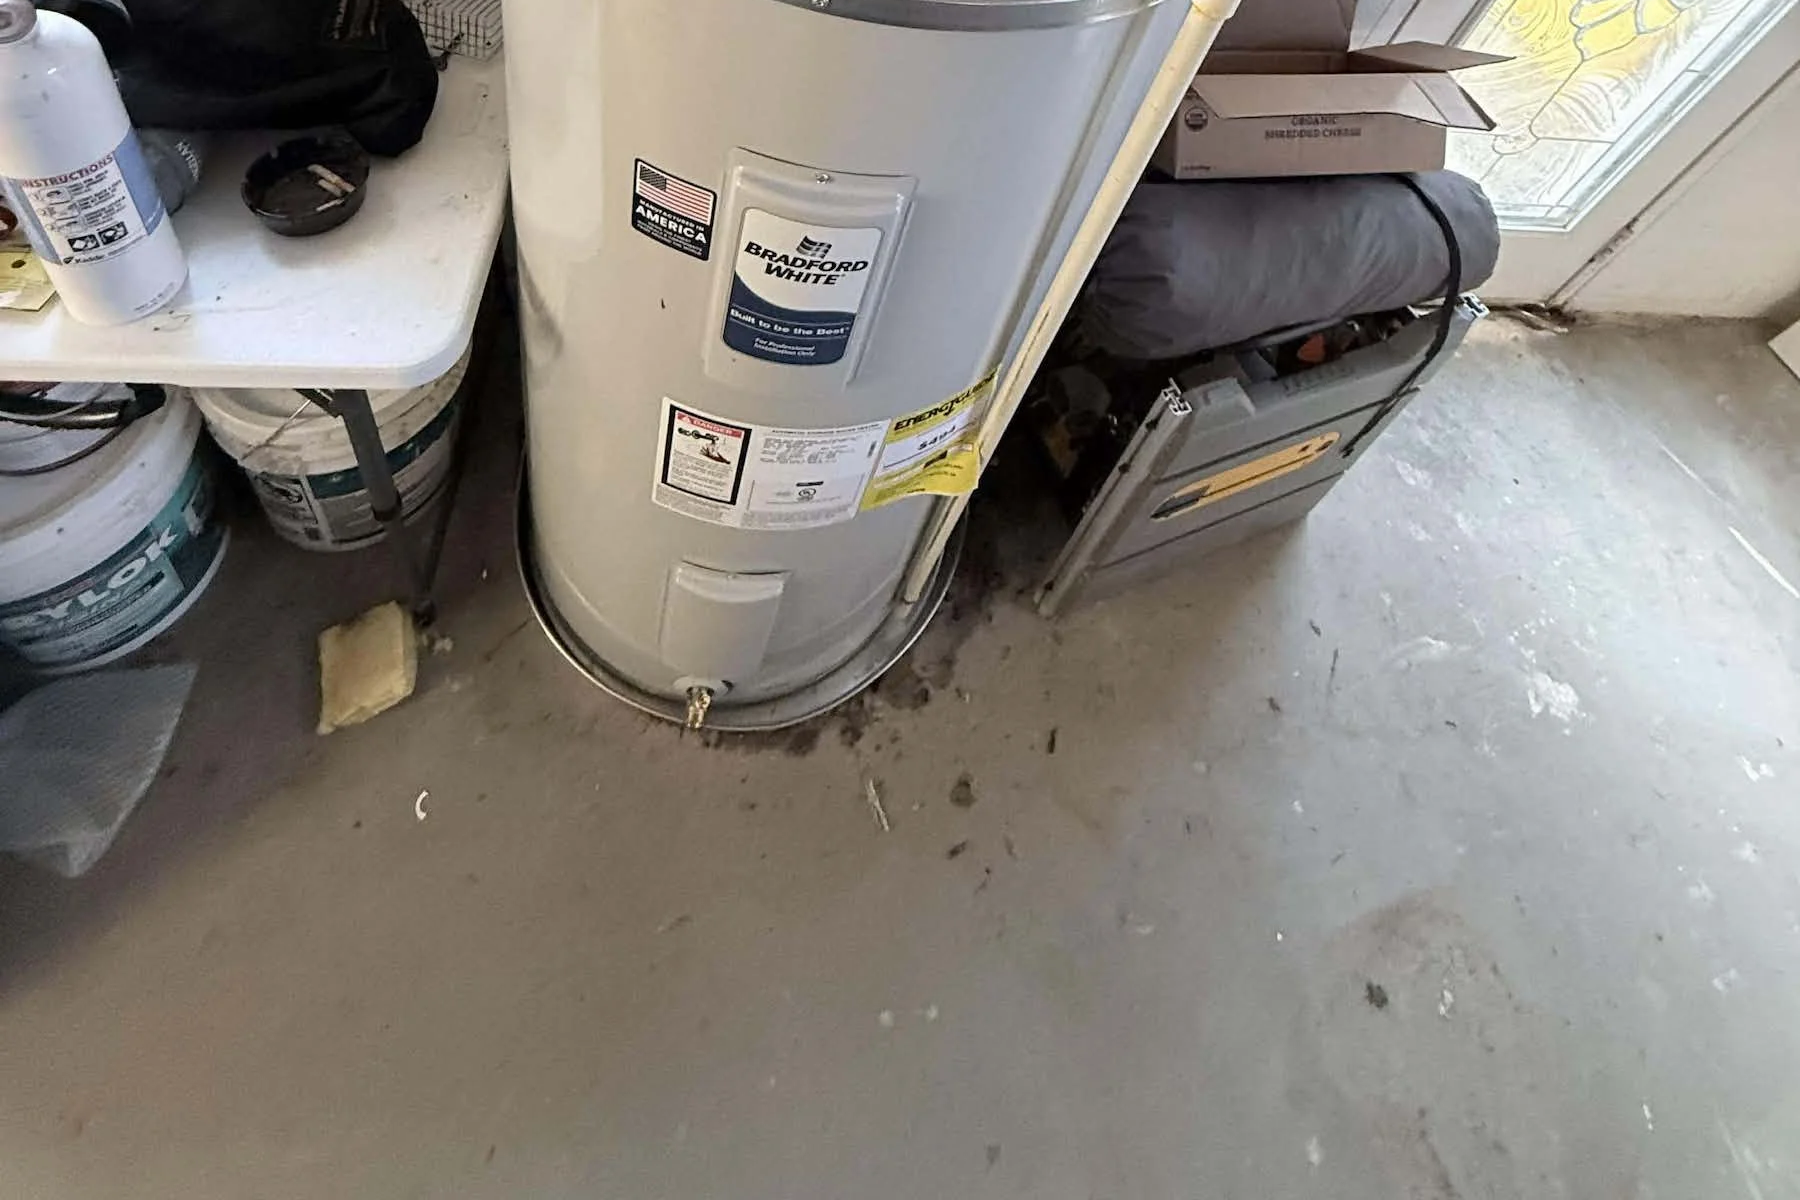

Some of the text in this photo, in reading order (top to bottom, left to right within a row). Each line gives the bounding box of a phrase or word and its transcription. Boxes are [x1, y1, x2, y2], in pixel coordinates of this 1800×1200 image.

[635, 204, 707, 244] AMERICA
[744, 240, 869, 272] BRADFORD
[730, 308, 757, 324] Built
[759, 318, 771, 330] to
[773, 322, 790, 334] be
[793, 324, 813, 336] the
[755, 336, 816, 351] For Professional
